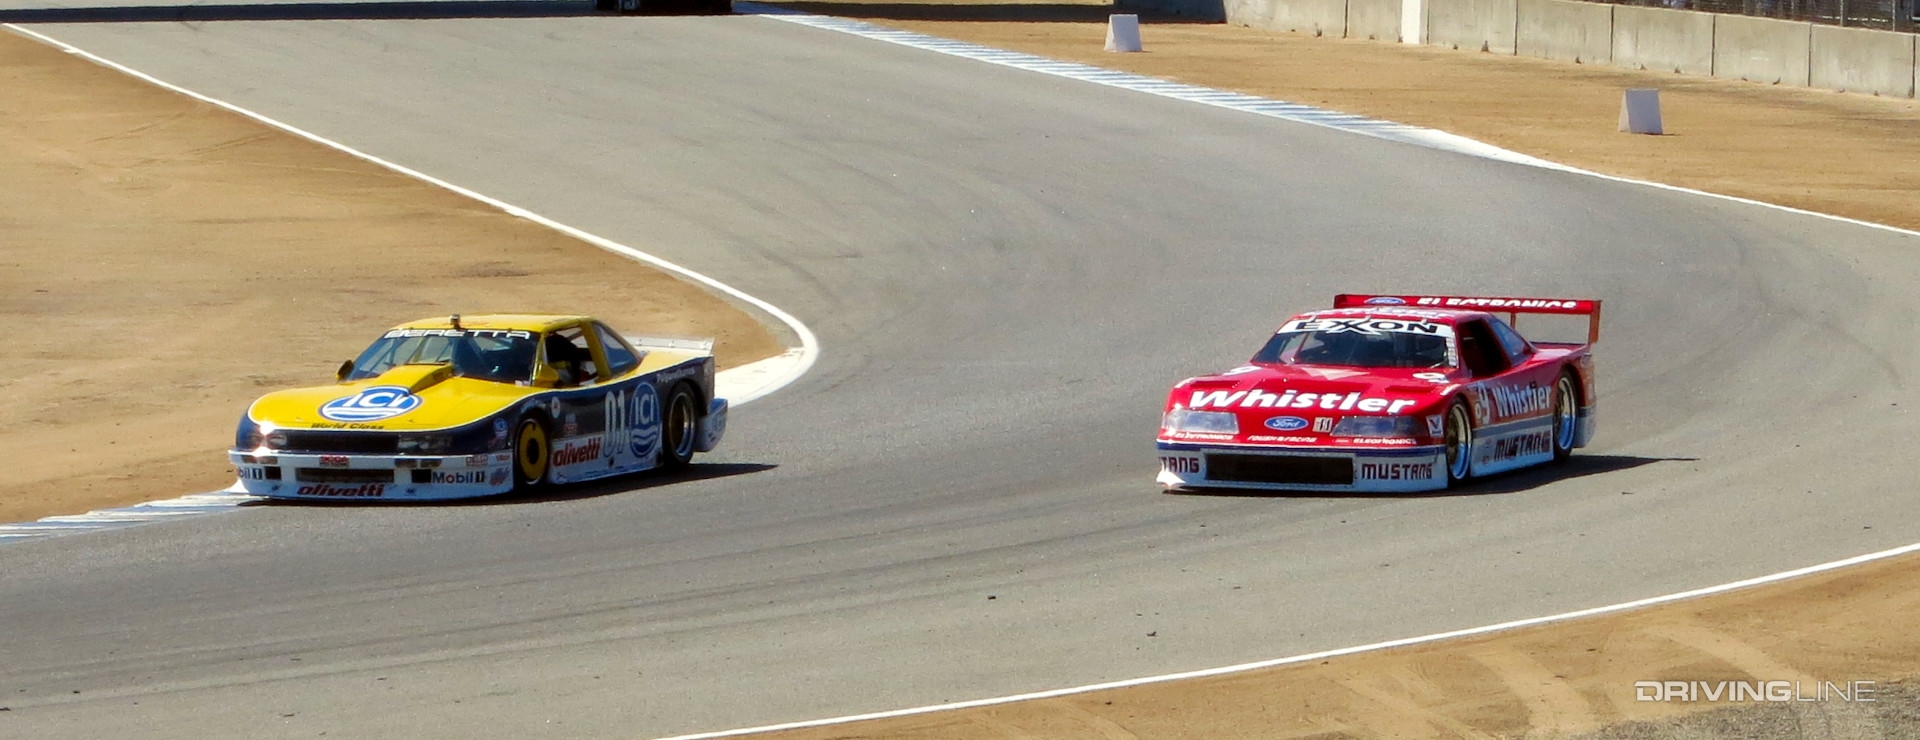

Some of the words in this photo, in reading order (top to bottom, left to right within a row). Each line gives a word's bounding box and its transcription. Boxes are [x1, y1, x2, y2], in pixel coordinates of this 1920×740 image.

[384, 329, 530, 340] BERETTA
[1295, 320, 1438, 334] EXXON
[342, 392, 409, 408] ICI
[1188, 389, 1416, 414] Whistler
[634, 393, 654, 425] ICI
[603, 389, 627, 457] 01
[552, 437, 601, 467] olivetti
[1494, 430, 1552, 462] MUSTANG
[432, 471, 474, 484] Mobil
[1361, 463, 1434, 480] MUSTANG
[296, 484, 386, 497] olivetti
